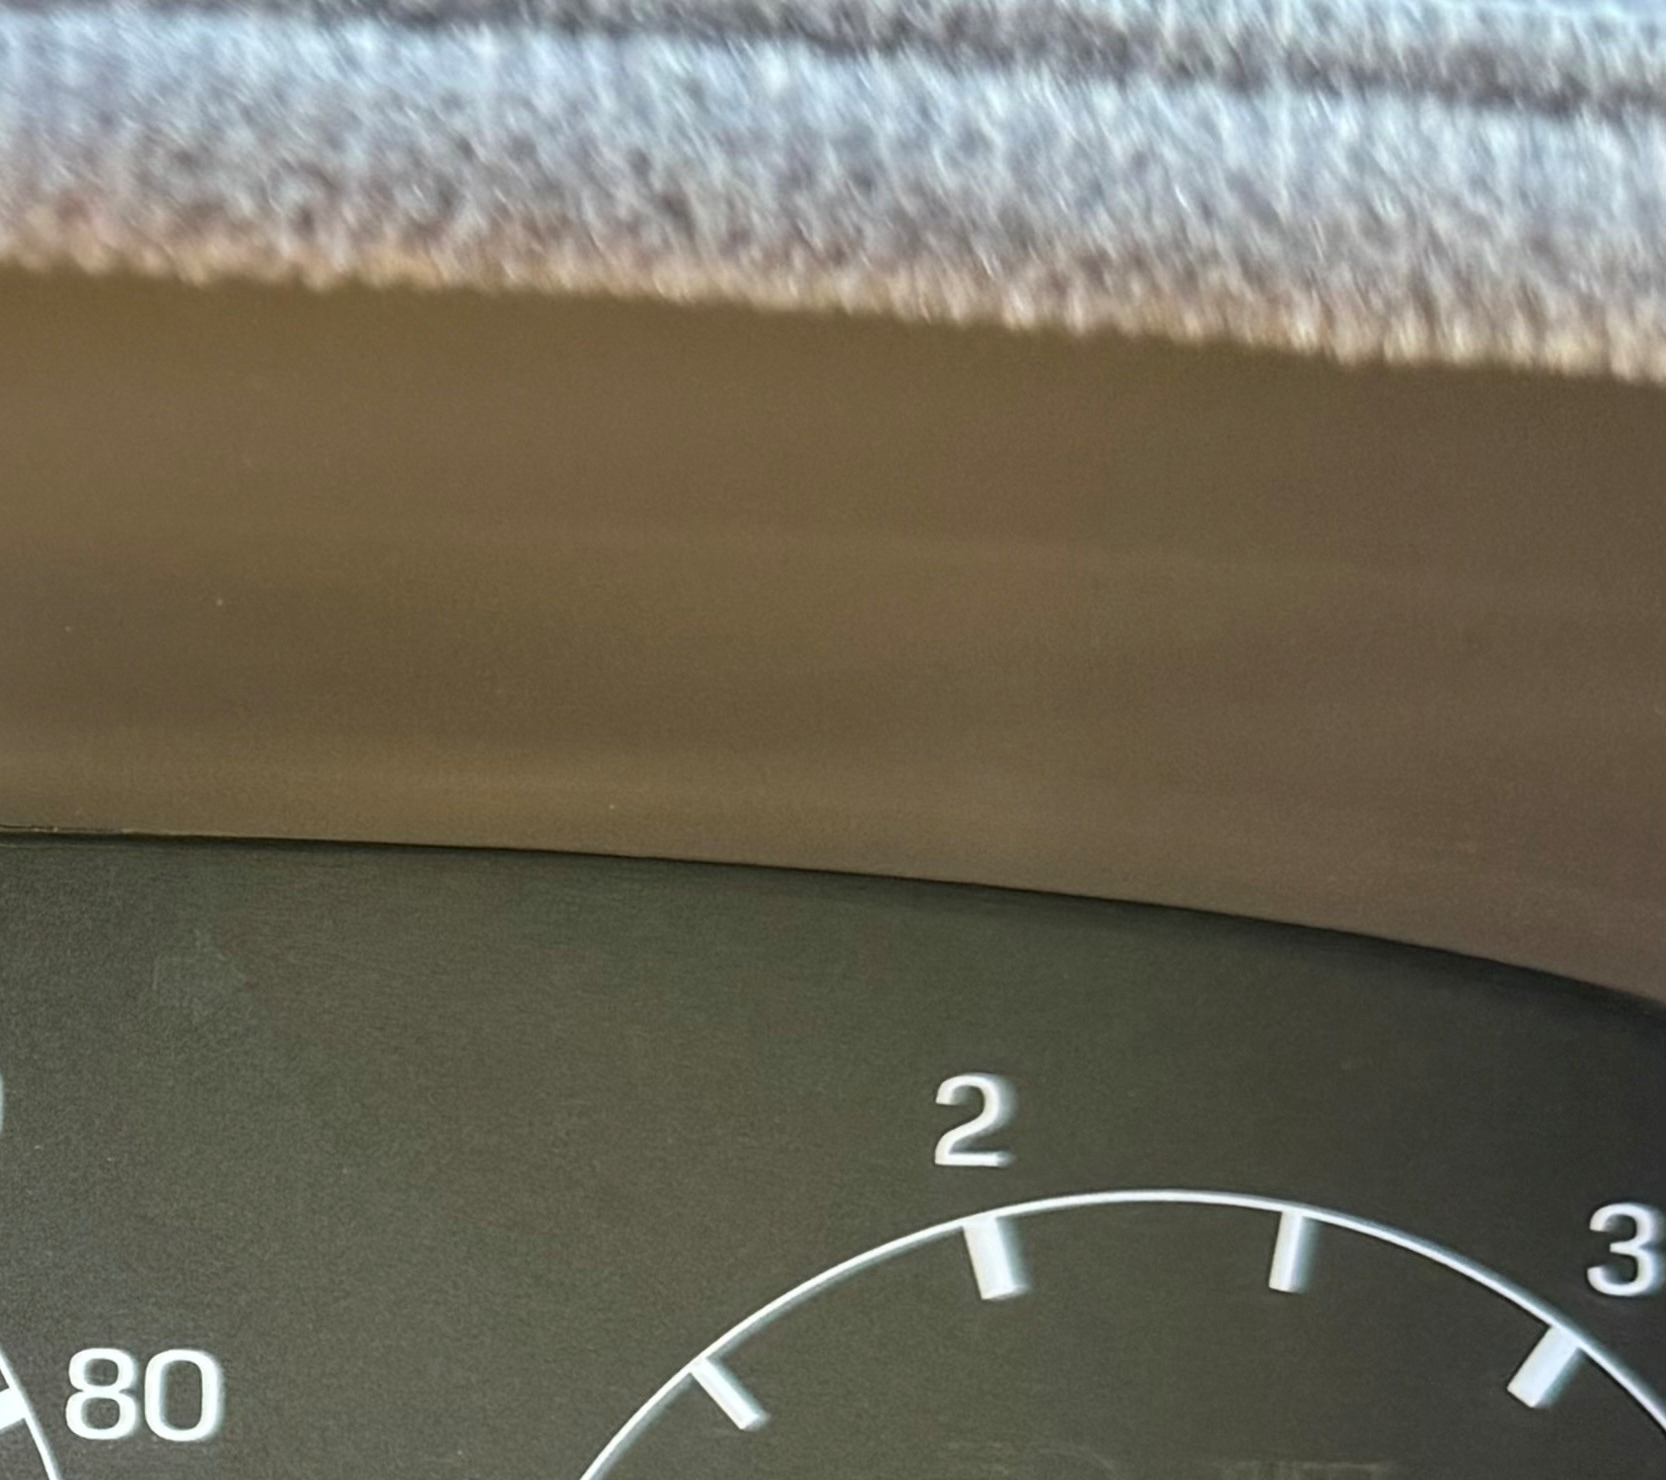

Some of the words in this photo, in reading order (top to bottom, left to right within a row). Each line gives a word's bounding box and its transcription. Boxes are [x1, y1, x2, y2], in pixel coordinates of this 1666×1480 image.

[934, 1073, 1008, 1168] 2
[1587, 1202, 1658, 1297] 3
[64, 1346, 223, 1443] 80
